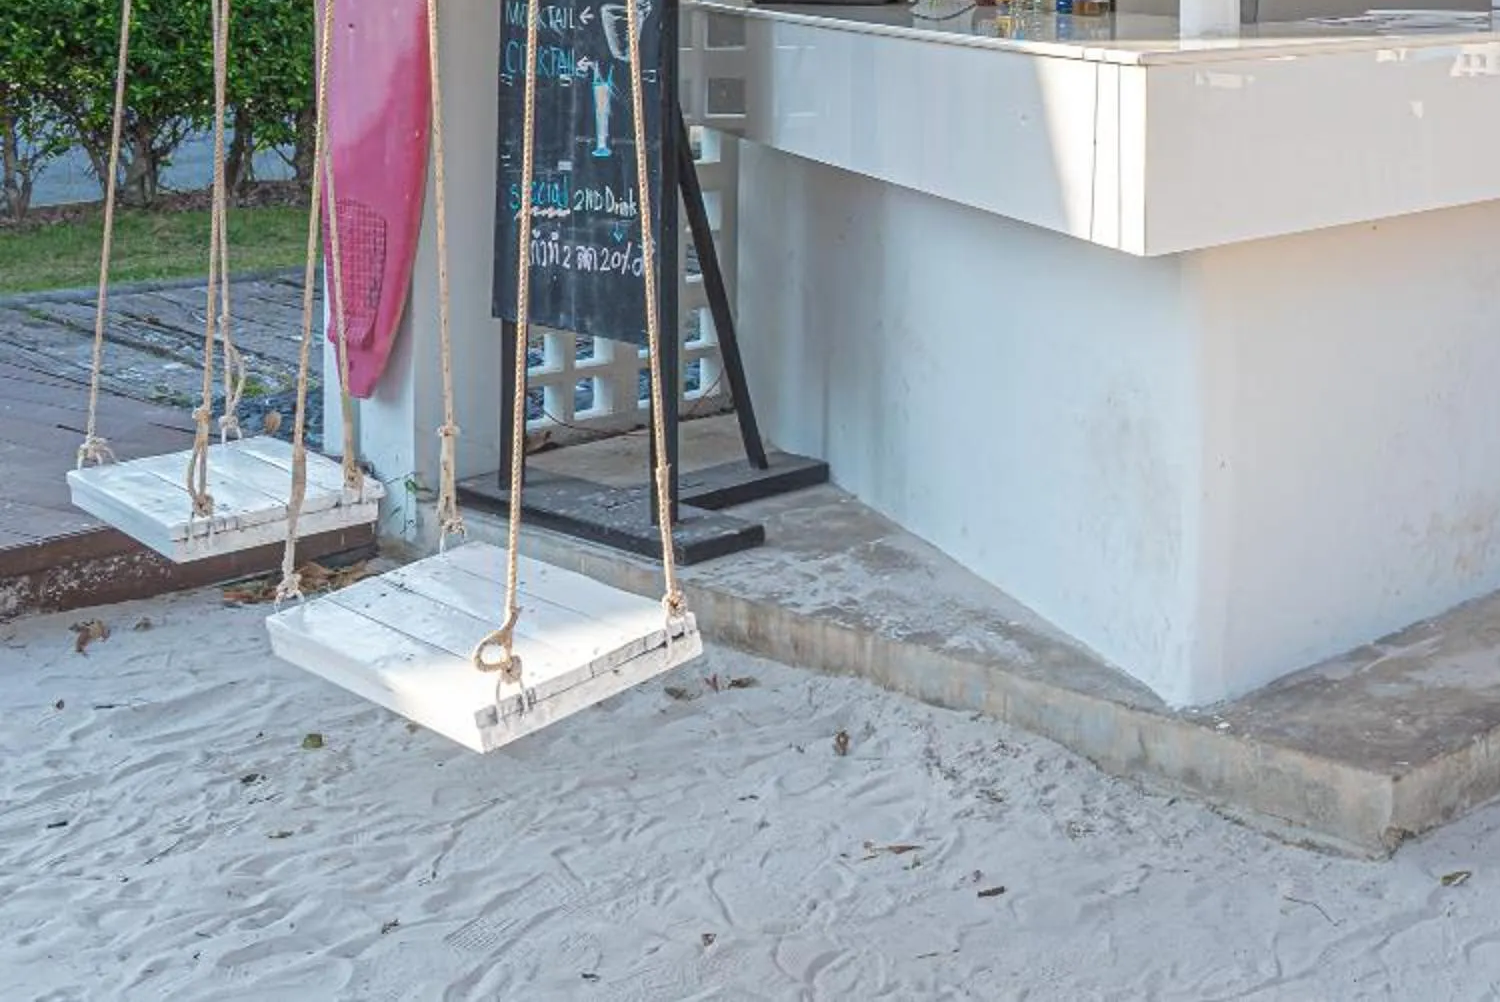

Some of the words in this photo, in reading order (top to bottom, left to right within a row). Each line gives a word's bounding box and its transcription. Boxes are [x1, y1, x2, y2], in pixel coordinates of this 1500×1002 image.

[505, 0, 576, 31] MOKTAIL
[505, 39, 577, 78] COKTAIL
[510, 174, 569, 210] Secial
